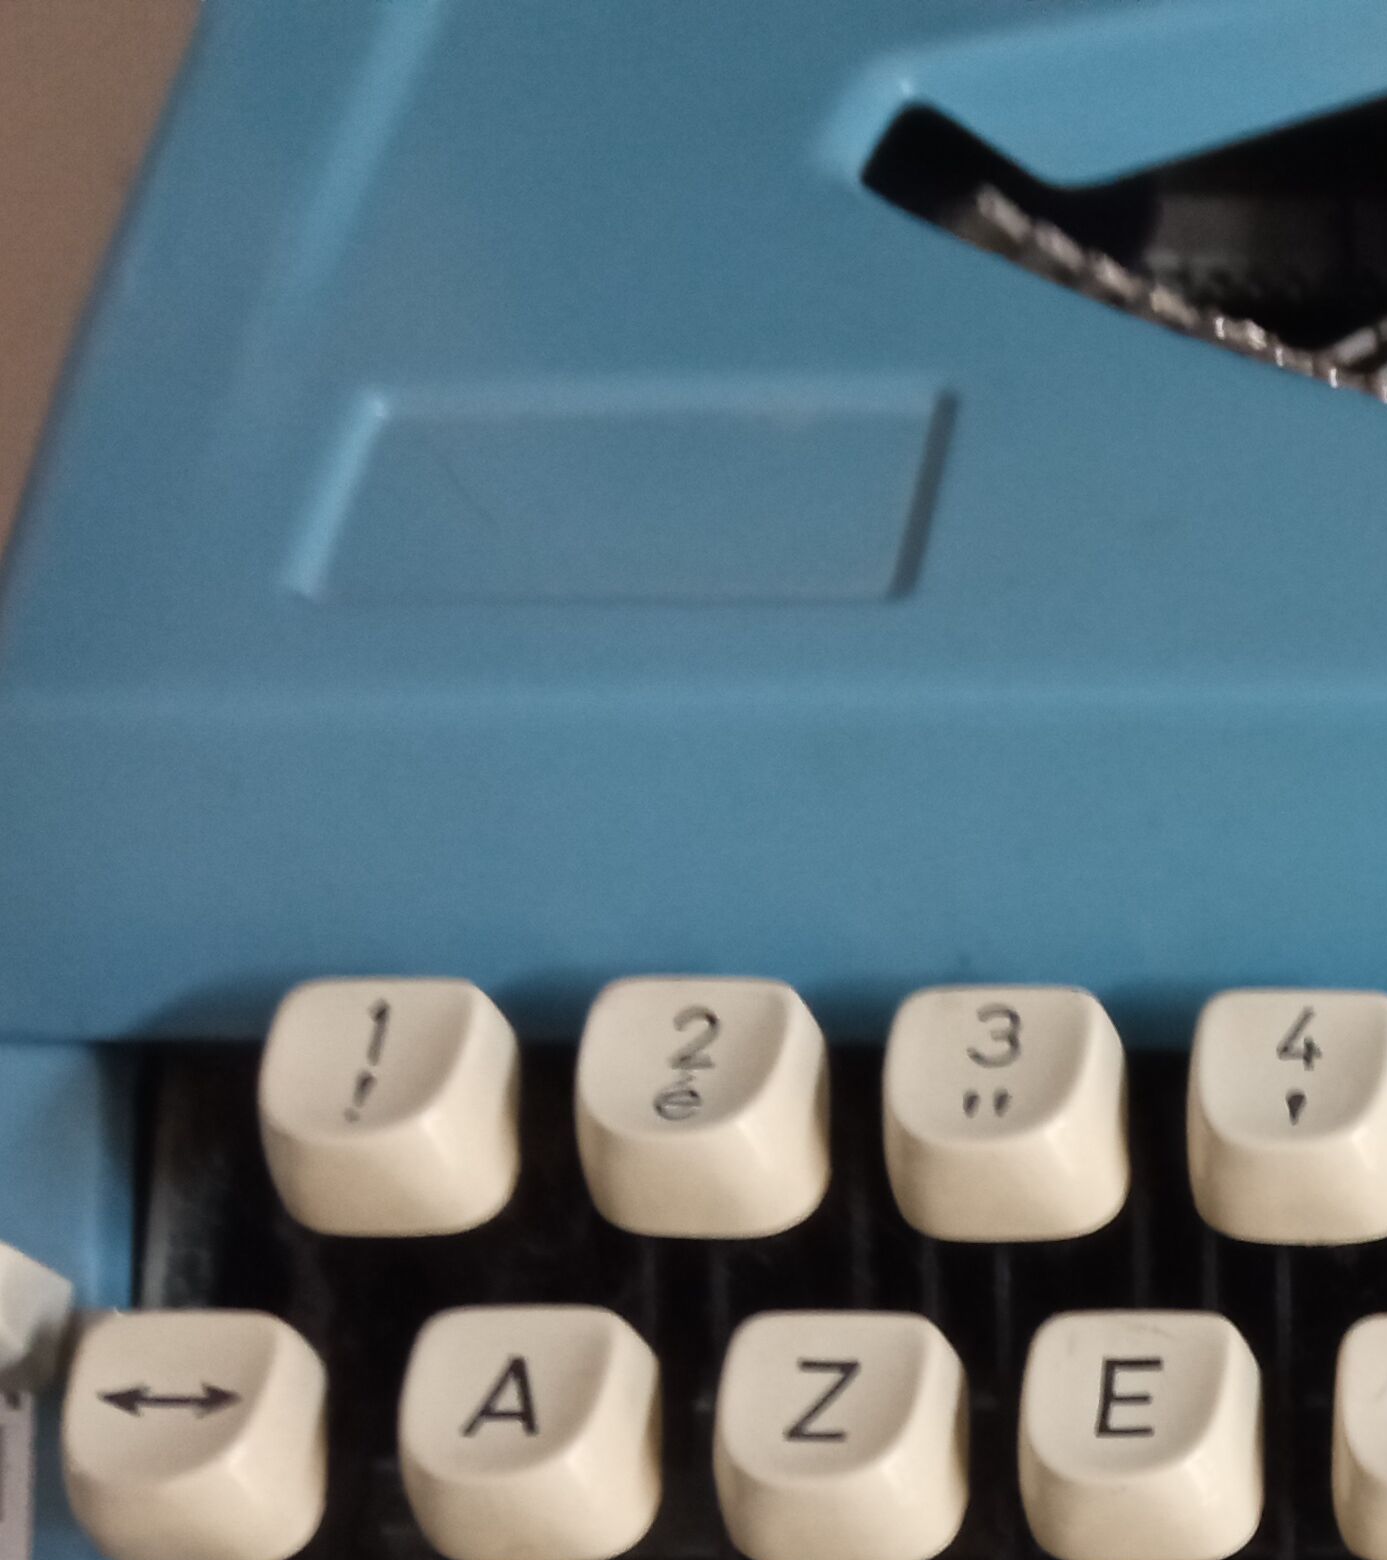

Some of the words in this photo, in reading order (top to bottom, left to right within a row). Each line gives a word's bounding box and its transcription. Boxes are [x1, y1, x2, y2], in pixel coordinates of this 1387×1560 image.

[367, 998, 391, 1066] 1
[670, 1005, 721, 1071] 2
[966, 1003, 1022, 1069] 3
[1276, 1008, 1322, 1071] 4
[343, 1070, 377, 1124] !
[461, 1355, 540, 1438] A
[782, 1357, 861, 1443] Z
[1094, 1356, 1164, 1438] E
